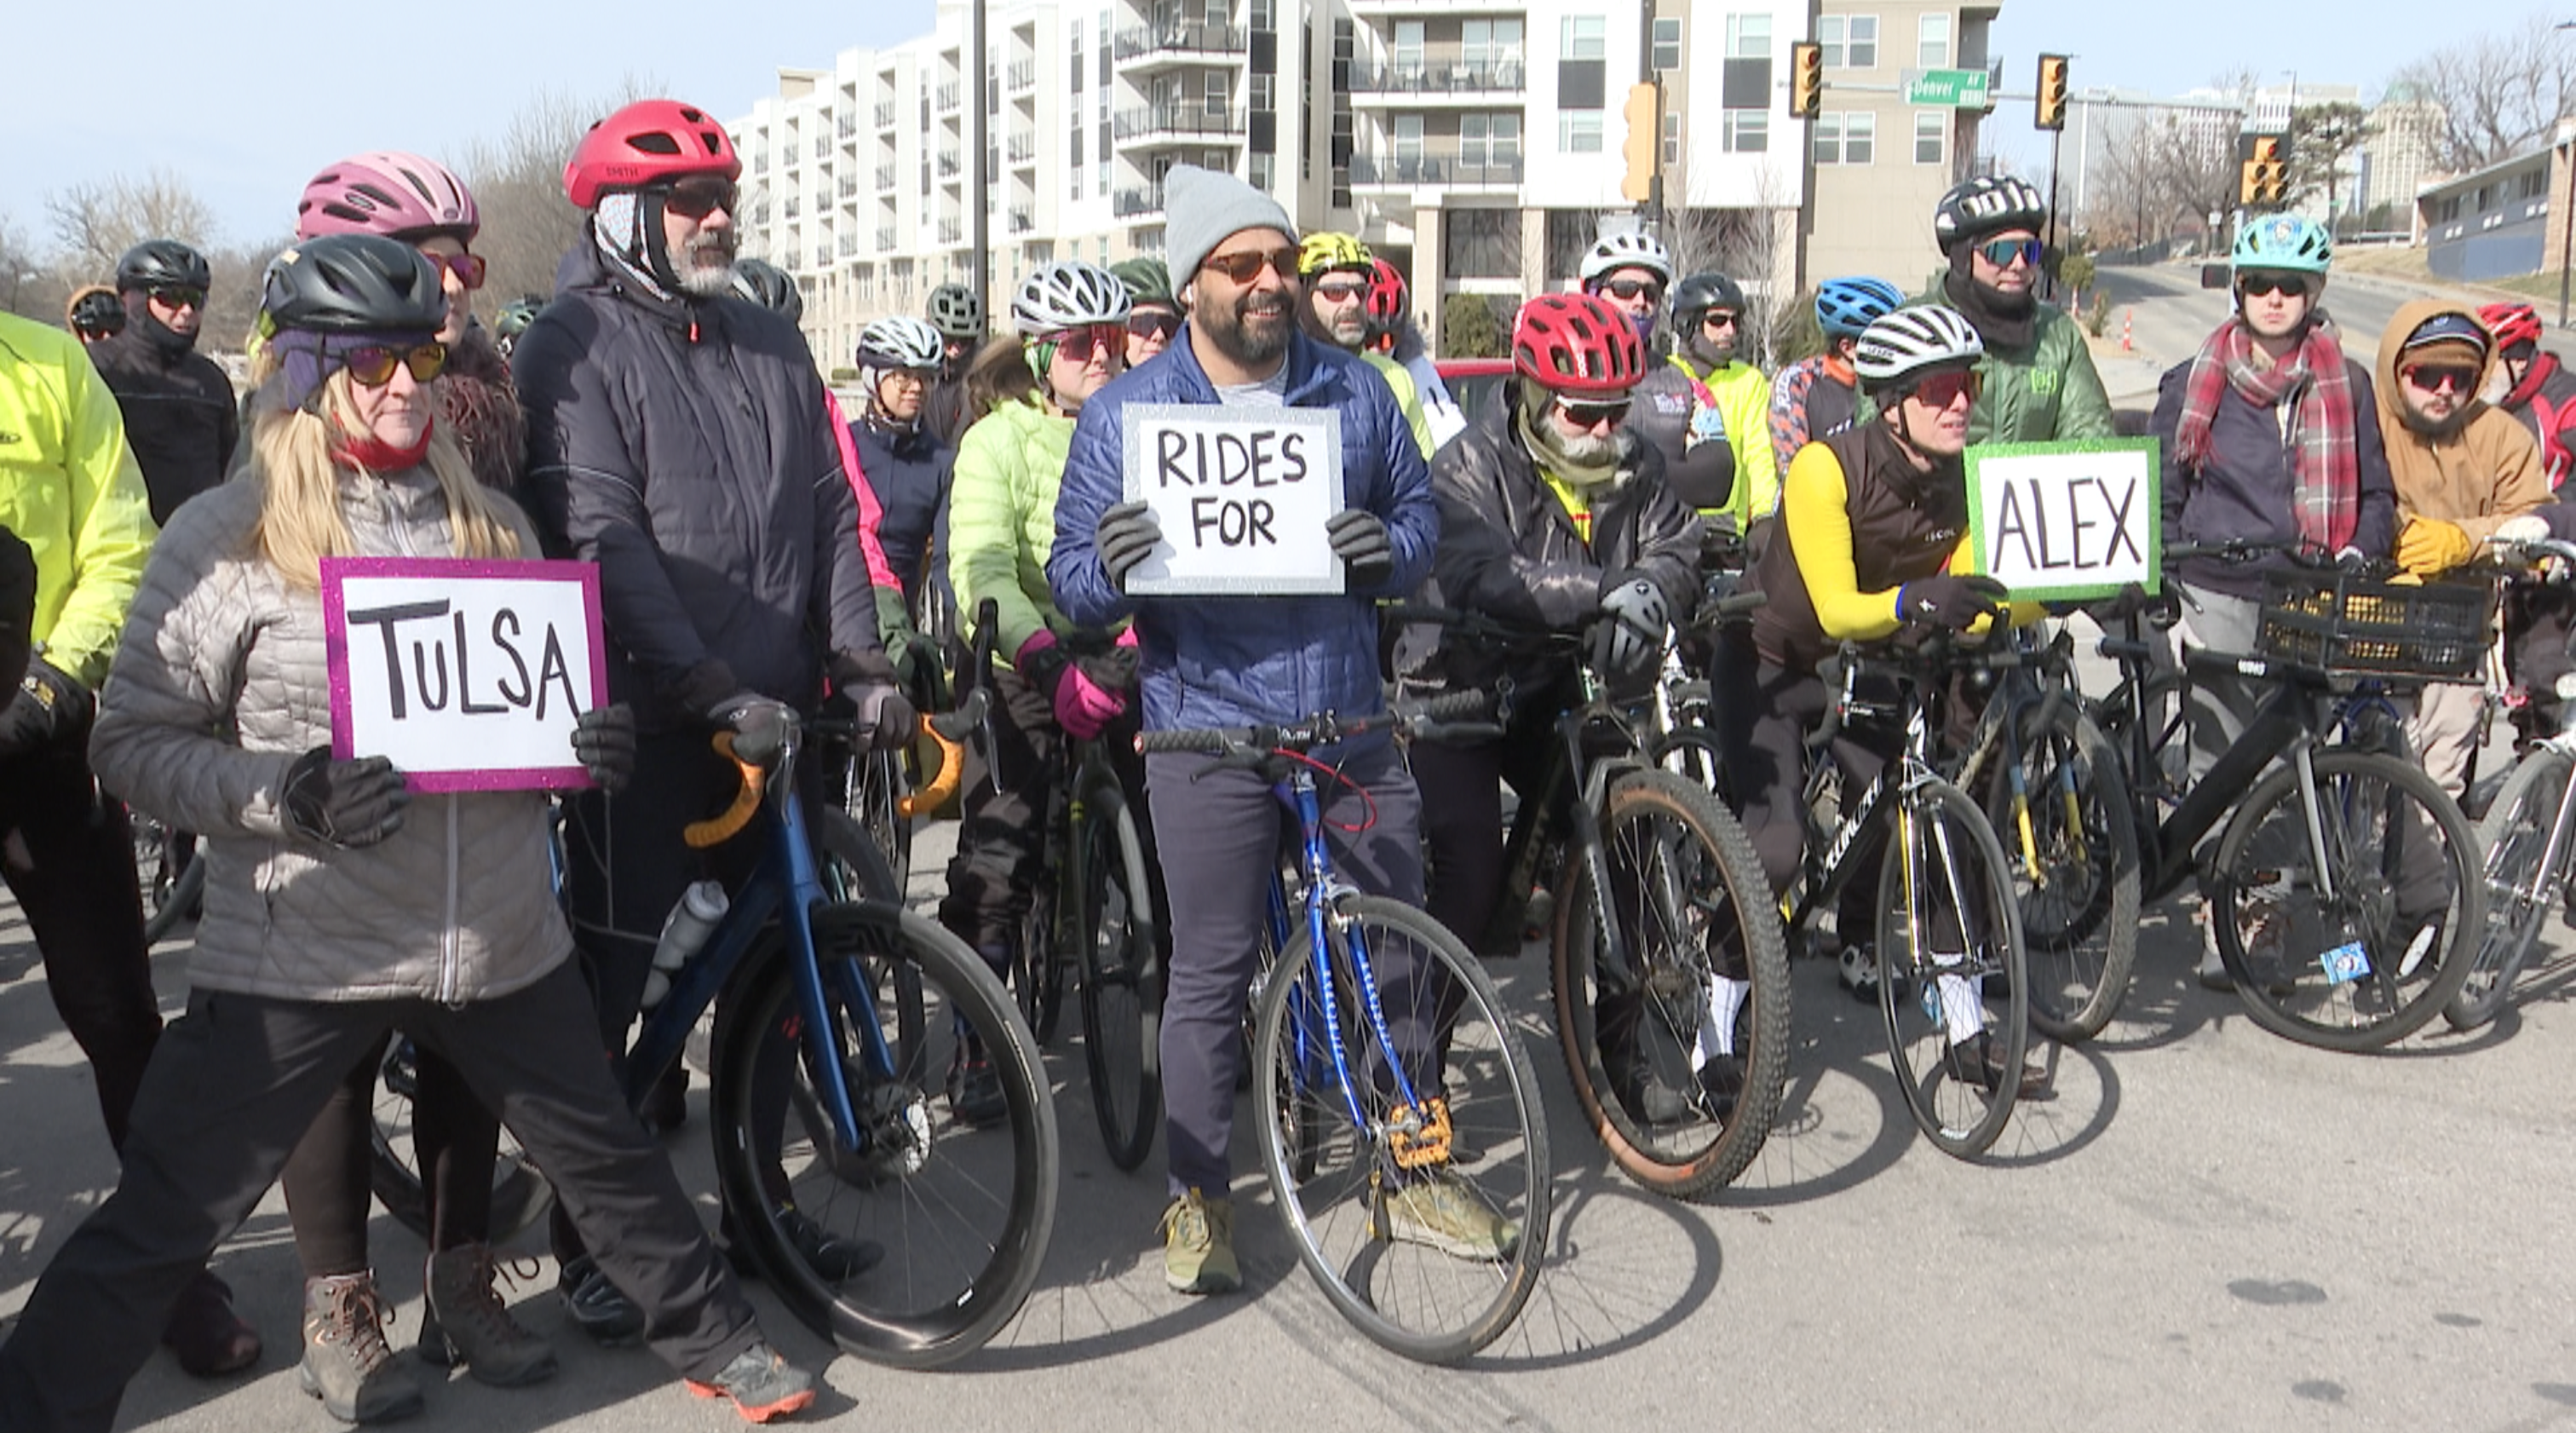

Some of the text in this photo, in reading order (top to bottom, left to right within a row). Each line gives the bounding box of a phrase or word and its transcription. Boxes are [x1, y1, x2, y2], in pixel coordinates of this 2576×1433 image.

[1912, 78, 1954, 98] Denver
[606, 165, 639, 177] SMITH
[1157, 429, 1308, 488] RIDES
[1191, 495, 1278, 548] FOR
[1992, 476, 2142, 573] ALEX
[347, 598, 581, 726] TULSA
